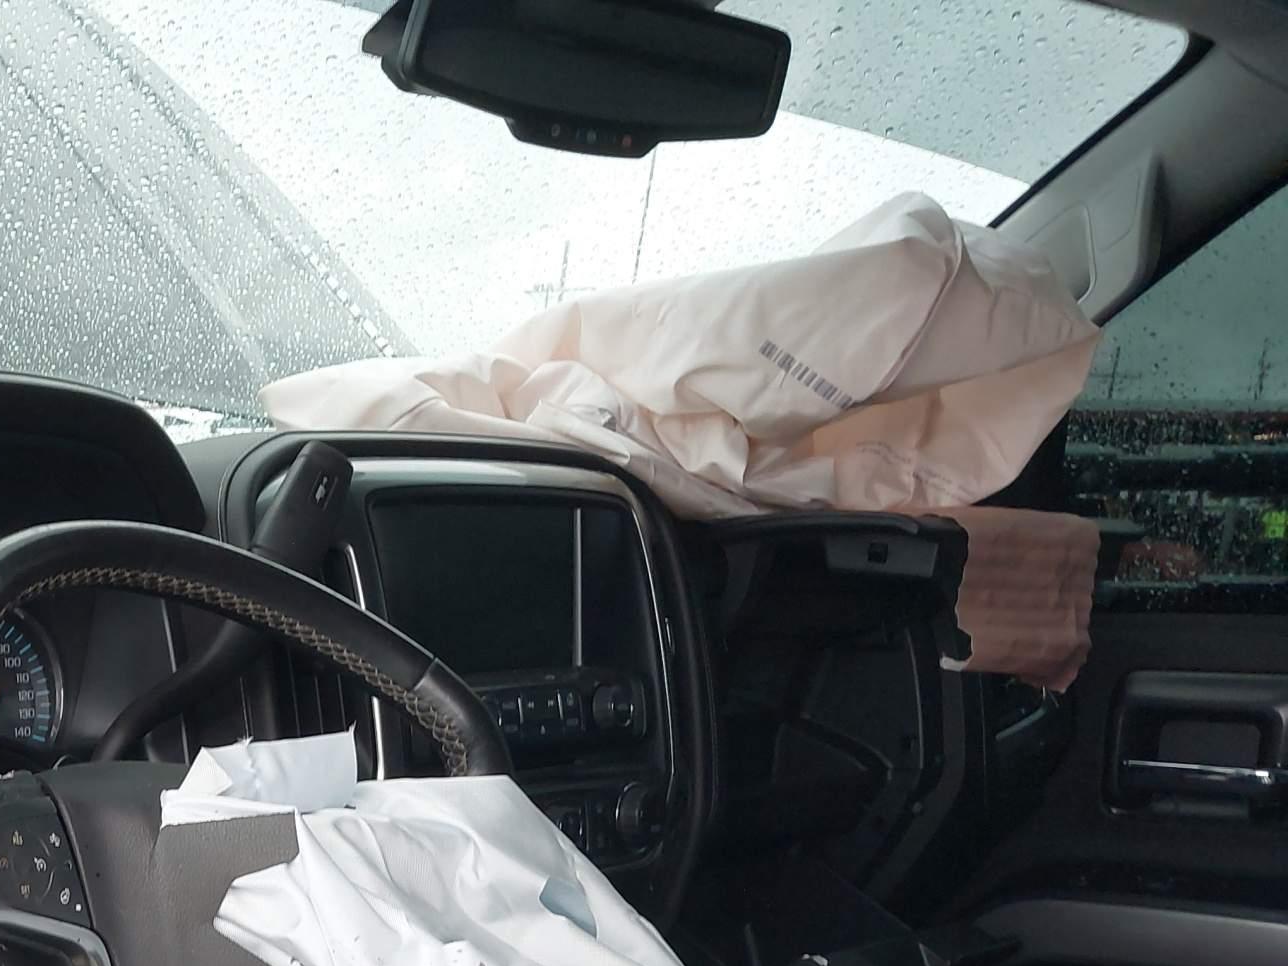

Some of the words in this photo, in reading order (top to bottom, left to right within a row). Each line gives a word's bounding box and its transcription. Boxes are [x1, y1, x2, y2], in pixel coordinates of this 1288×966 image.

[4, 657, 21, 668] 100
[16, 672, 30, 684] 110
[18, 690, 34, 702] 120
[19, 708, 35, 719] 130
[14, 727, 31, 738] 140
